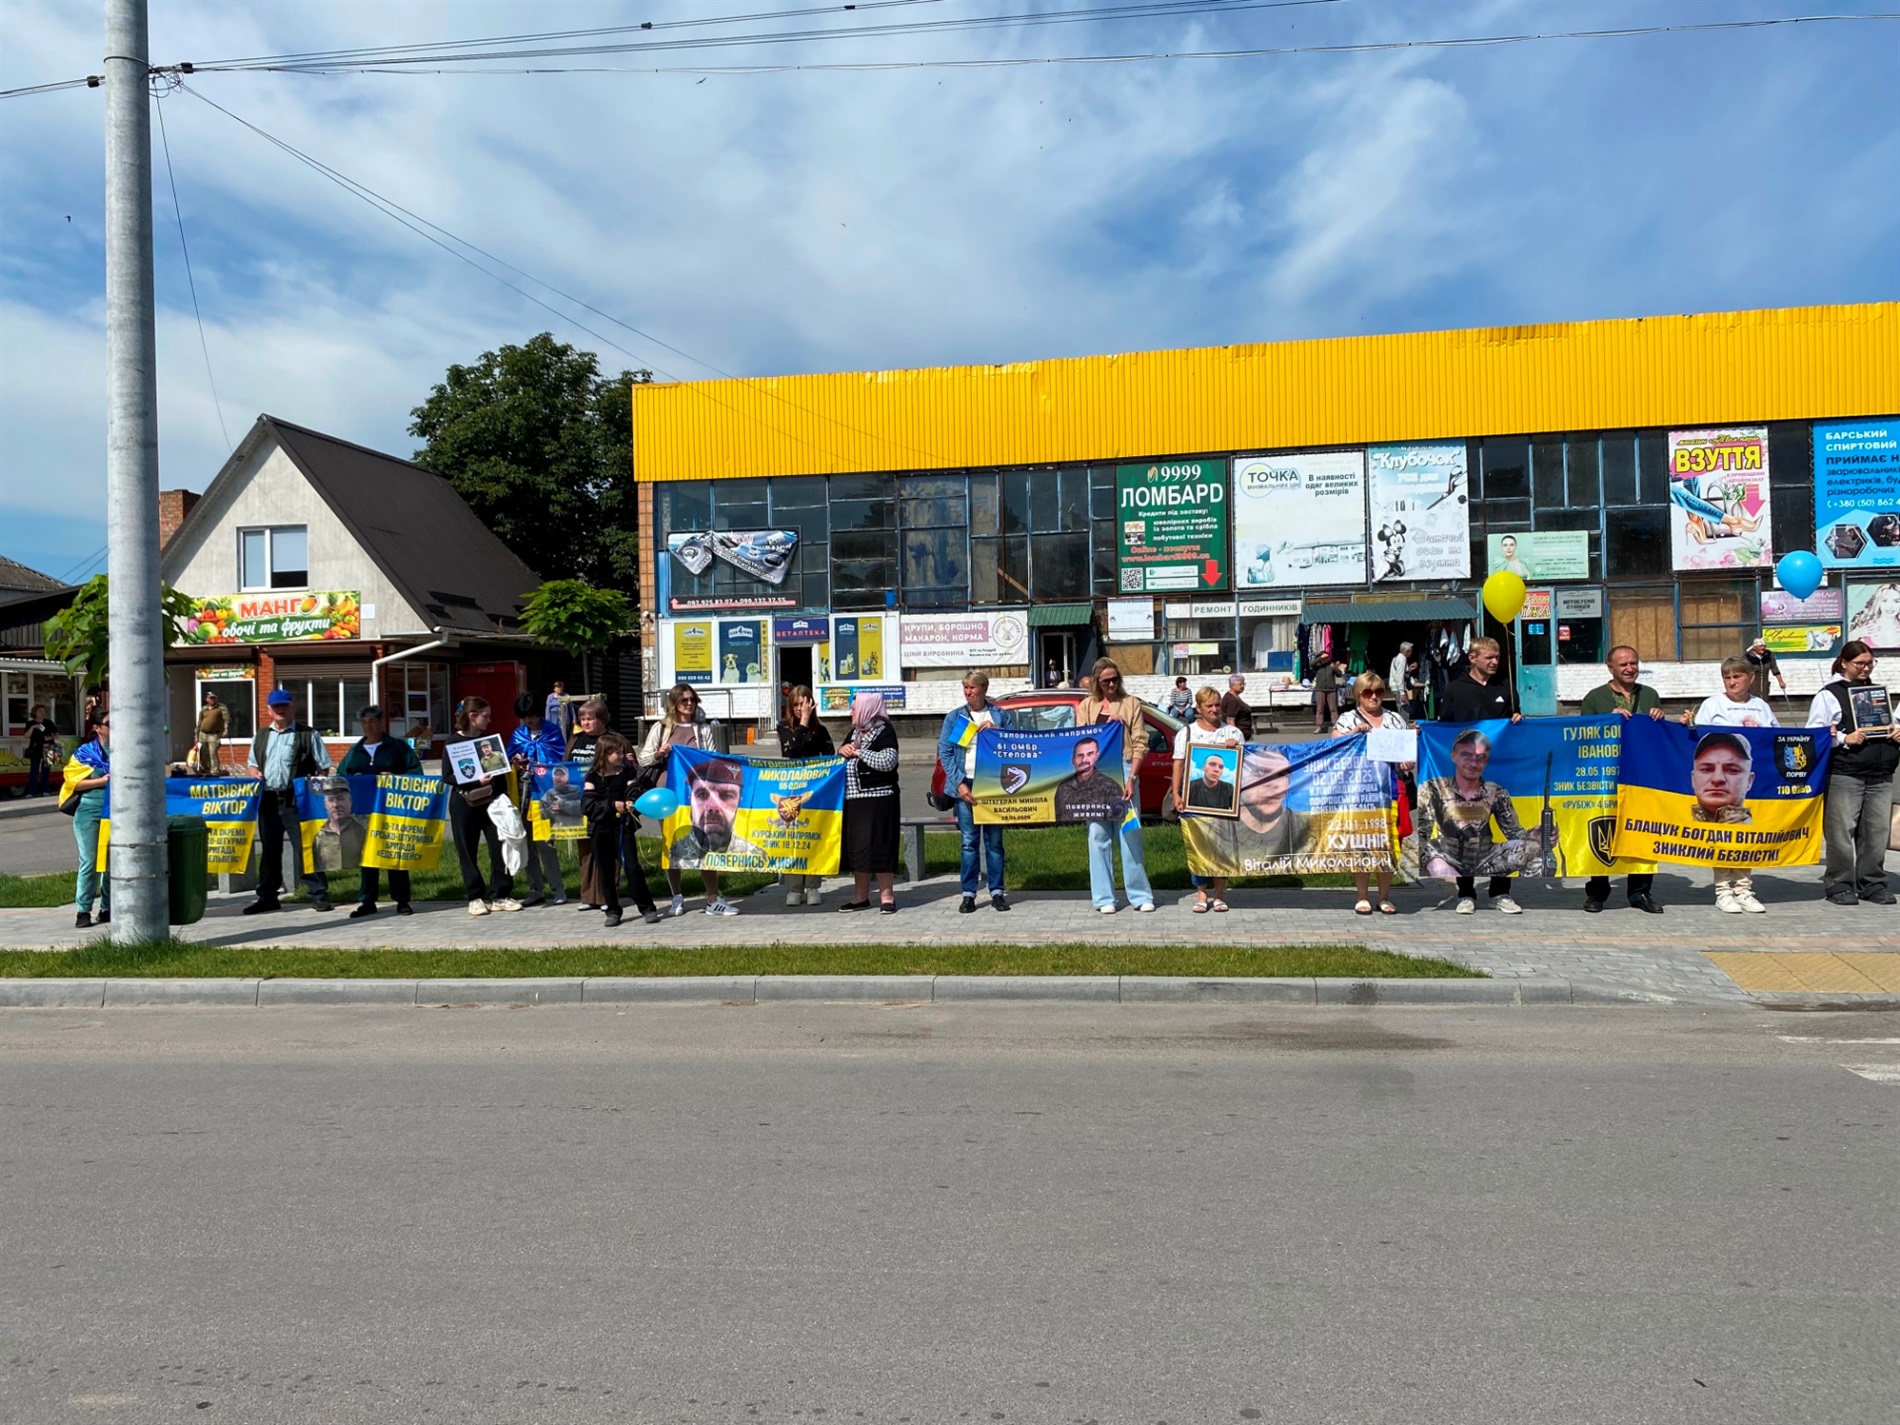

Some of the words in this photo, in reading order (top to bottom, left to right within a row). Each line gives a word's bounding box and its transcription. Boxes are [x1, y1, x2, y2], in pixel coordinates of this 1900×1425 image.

[1825, 428, 1888, 440] БАРСЬКИЙ
[1825, 440, 1897, 452] СПИРТОВИЙ
[1674, 444, 1763, 473] ВЗУТТЯ
[1825, 453, 1887, 466] ПРИЙМАЄ
[1160, 464, 1202, 482] 9999
[1247, 470, 1299, 483] ТОЧКА
[1308, 474, 1314, 482] В
[1316, 472, 1356, 481] наявності
[1315, 487, 1350, 497] розмірів
[1826, 486, 1896, 497] різноробочих
[1857, 499, 1875, 507] (50)
[1194, 605, 1233, 614] РЕМОНТ
[1243, 603, 1298, 612] ГОДИННИКІВ
[222, 620, 256, 638] овочі
[259, 623, 278, 634] та
[281, 618, 331, 637] фрукти
[904, 624, 937, 633] КРУПИ,
[939, 622, 987, 632] БОРОШНО,
[905, 635, 950, 643] МАКАРОН,
[952, 633, 983, 641] КОРМА
[1562, 726, 1601, 741] ГУЛЯК
[1578, 744, 1621, 759] ІВАНОВ
[758, 768, 831, 781] МИКОЛАЙОВИЧ
[1553, 781, 1575, 791] ЗНИК
[1576, 780, 1615, 791] БЕЗВІСТИ
[1777, 785, 1791, 794] 110
[202, 800, 247, 815] ВІКТОР
[385, 792, 430, 811] ВІКТОР
[751, 829, 788, 840] КУРСЬКИЙ
[788, 830, 822, 840] НАПРЯМОК
[1624, 818, 1679, 837] БЛАЩУК
[1681, 826, 1732, 844] БОГДАН
[1735, 826, 1810, 845] ВІТАЛІЙОВИЧ
[763, 839, 780, 848] ЗНИК
[1327, 833, 1389, 850] КУШНІР
[1652, 841, 1716, 860] ЗНИКЛИЙ
[1717, 848, 1780, 862] БЕЗВІСТИ!
[706, 853, 765, 868] ПОВЕРНИСЬ
[768, 856, 808, 870] ЖИВИМ
[1244, 856, 1293, 872] Віталій
[1296, 852, 1392, 870] Миколайович
